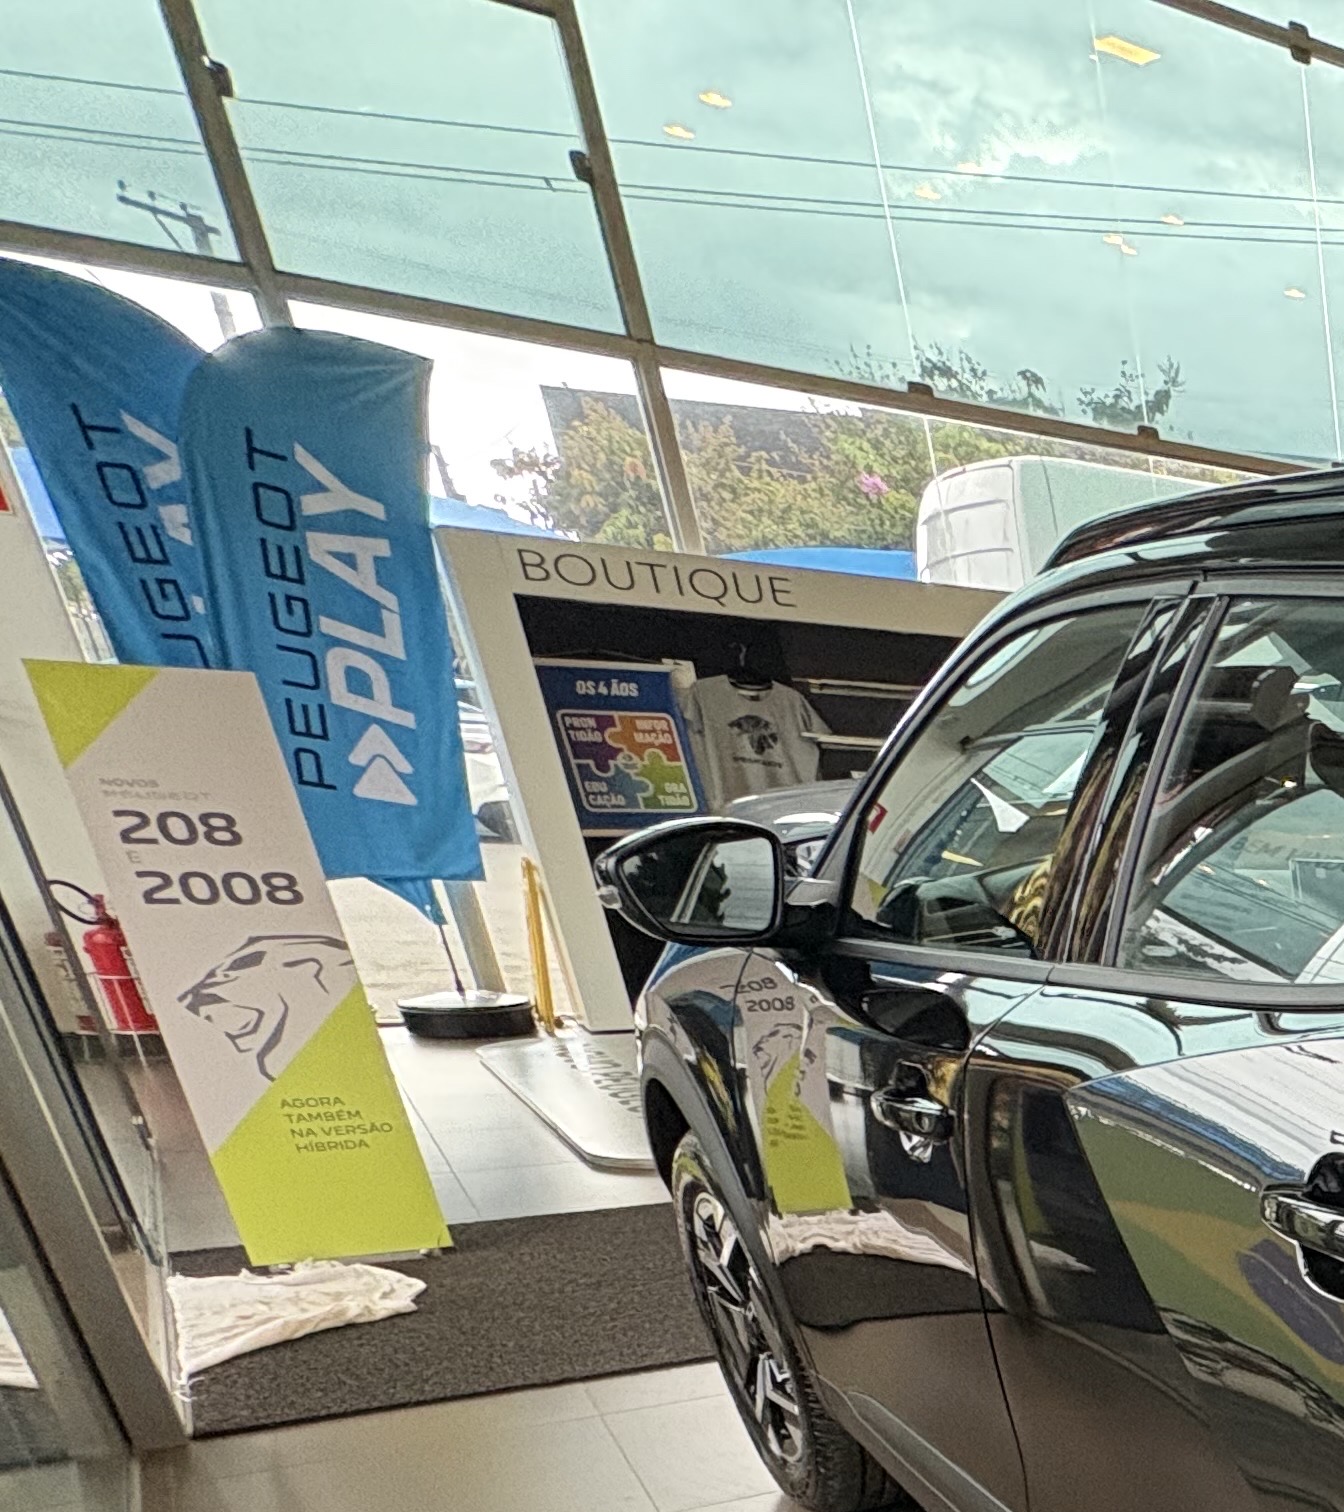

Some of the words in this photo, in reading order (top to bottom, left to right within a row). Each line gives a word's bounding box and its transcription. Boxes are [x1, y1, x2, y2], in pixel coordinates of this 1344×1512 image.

[70, 402, 213, 669] UGEOT
[293, 440, 417, 730] PLAY
[516, 548, 798, 608] BOUTIQUE
[244, 426, 338, 791] PEUGEOT
[575, 679, 596, 696] OS
[597, 680, 609, 696] 4
[610, 678, 640, 697] ÃOS
[112, 809, 244, 847] 208
[135, 870, 305, 906] 2008
[280, 1096, 346, 1109] AGORA
[283, 1109, 364, 1124] TAMBÉM
[290, 1127, 318, 1138] NA
[320, 1122, 394, 1137] VERSÃO
[295, 1139, 371, 1153] HÍBRIDA
